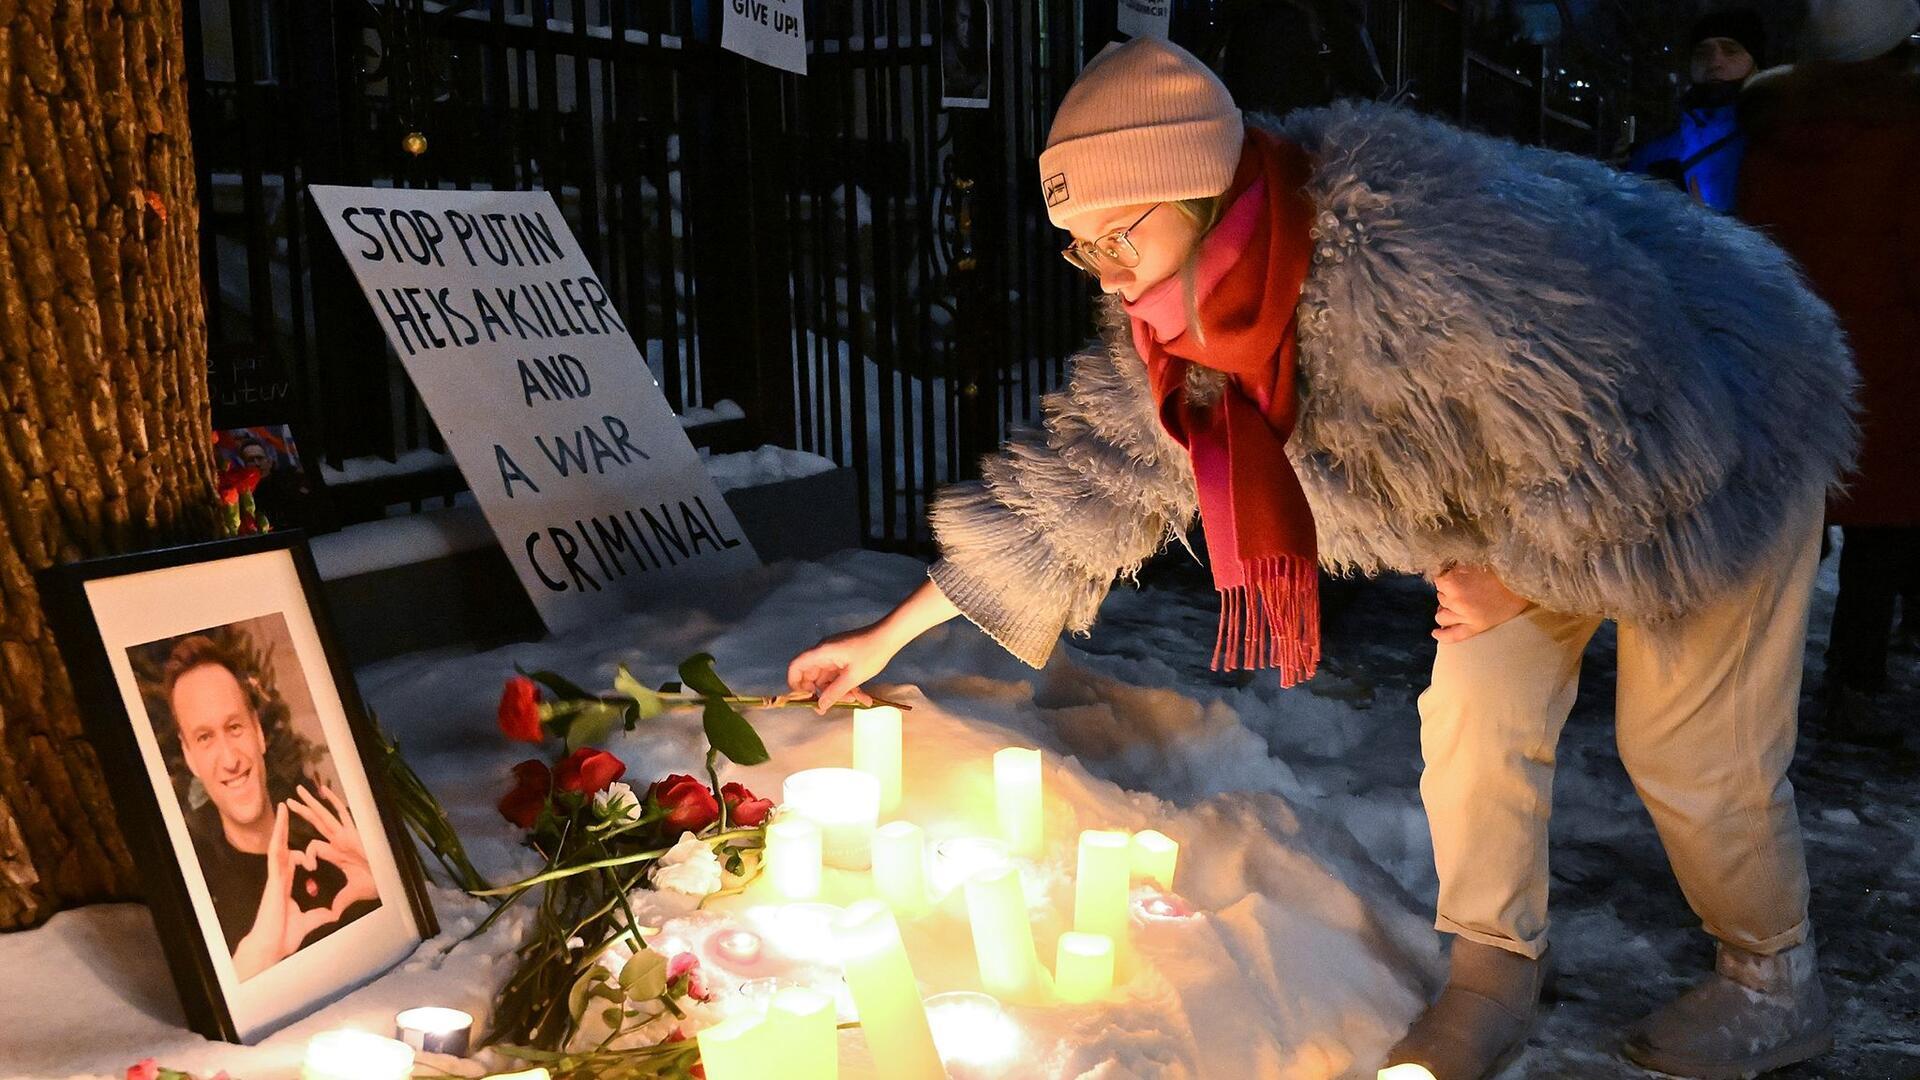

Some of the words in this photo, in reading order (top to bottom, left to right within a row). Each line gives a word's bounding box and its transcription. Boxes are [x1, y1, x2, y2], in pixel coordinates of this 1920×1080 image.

[733, 0, 768, 26] GIVE
[774, 10, 799, 38] UP!
[342, 207, 445, 267] STOP
[444, 209, 565, 267] PUTIN
[495, 276, 625, 340] KILLER
[517, 353, 592, 408] AND
[494, 443, 540, 499] A
[534, 415, 650, 478] WAR
[525, 495, 741, 593] CRIMINAL
